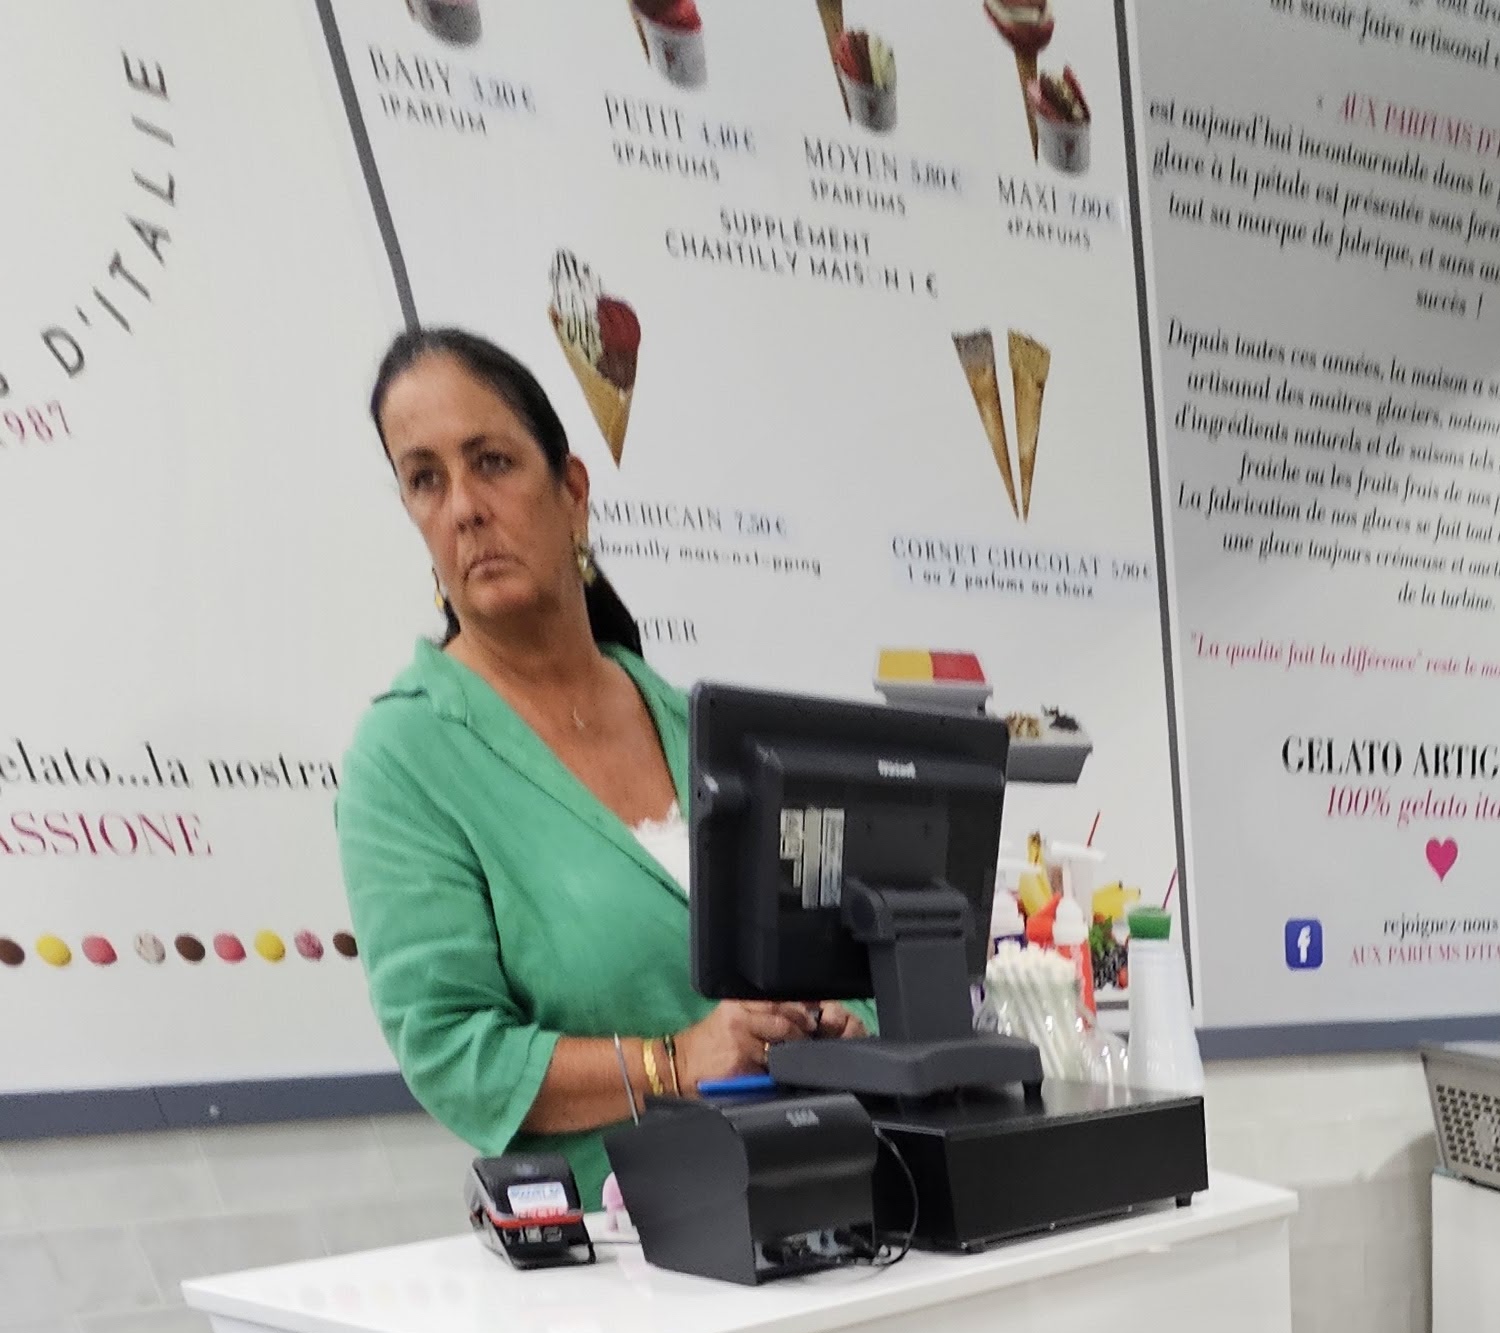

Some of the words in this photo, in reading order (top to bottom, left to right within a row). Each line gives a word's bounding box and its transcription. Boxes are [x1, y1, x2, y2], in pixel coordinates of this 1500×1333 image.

[367, 43, 452, 96] BABY
[604, 90, 685, 140] PETIT
[804, 136, 898, 182] MOYEN
[1181, 109, 1293, 155] aujourd'hui
[1433, 159, 1472, 195] dans
[1478, 168, 1492, 199] le
[40, 47, 176, 379] D'ITALIE
[997, 173, 1058, 215] MAXI
[1153, 145, 1203, 176] glace
[1230, 159, 1247, 188] la
[1428, 209, 1463, 238] sous
[664, 226, 798, 277] CHANTILLY
[1169, 192, 1203, 221] tout
[1210, 206, 1230, 229] sa
[1237, 211, 1306, 249] marque
[1312, 220, 1333, 248] de
[1419, 247, 1433, 269] et
[1438, 254, 1473, 278] sans
[1168, 318, 1228, 360] Depuis
[1235, 334, 1284, 366] toutes
[1290, 348, 1316, 372] ces
[1390, 358, 1405, 385] la
[1411, 368, 1467, 395] maison
[1187, 370, 1270, 403] artisanal
[1276, 378, 1303, 405] des
[0, 399, 72, 448] 987
[1294, 426, 1360, 453] naturels
[1366, 435, 1381, 456] et
[1386, 434, 1404, 459] de
[1305, 469, 1324, 488] ou
[1330, 463, 1350, 490] les
[1354, 466, 1398, 498] fruits
[1402, 474, 1438, 504] frais
[1443, 481, 1462, 503] de
[1467, 489, 1490, 507] nos
[1178, 482, 1201, 510] La
[1205, 487, 1300, 522] fabrication
[1306, 498, 1326, 523] de
[1331, 508, 1357, 528] nos
[1362, 506, 1410, 534] glaces
[1416, 519, 1431, 536] se
[1433, 516, 1461, 544] fait
[892, 535, 977, 566] CORNET
[987, 545, 1100, 577] CHOCOLAT
[1222, 532, 1254, 553] une
[1258, 528, 1303, 560] glace
[1308, 538, 1371, 568] toujours
[1450, 557, 1464, 574] et
[964, 570, 1025, 592] parfums
[1055, 577, 1094, 599] choix
[207, 751, 340, 792] nostra
[1281, 735, 1403, 778] GELATO
[1326, 784, 1391, 819] 100%
[1396, 787, 1467, 830] gelato
[1350, 942, 1382, 967] AUX
[1388, 943, 1460, 965] PARFUMS
